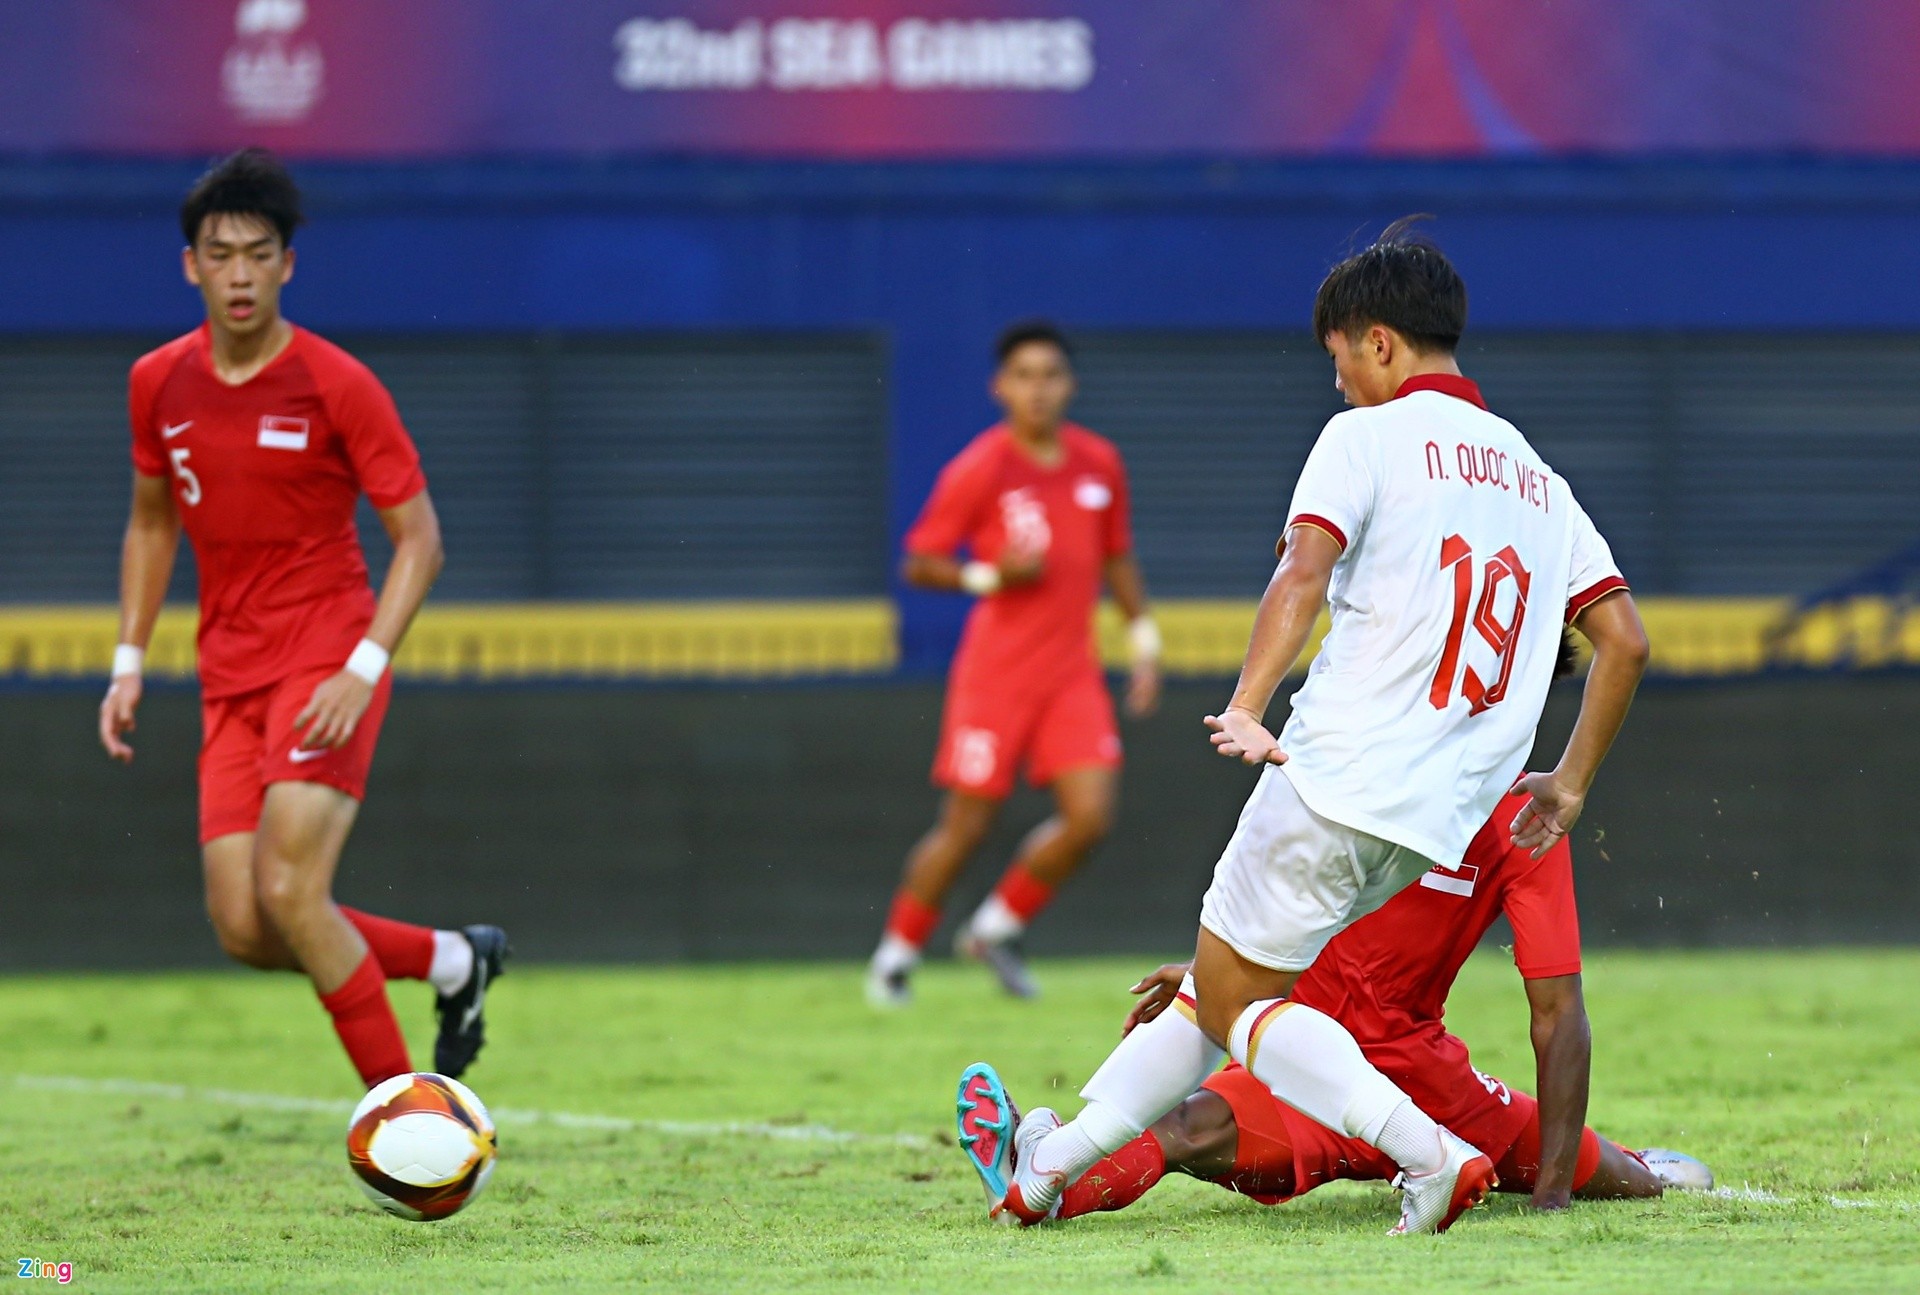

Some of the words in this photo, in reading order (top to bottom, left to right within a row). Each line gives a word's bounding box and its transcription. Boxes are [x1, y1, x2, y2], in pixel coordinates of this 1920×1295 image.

[614, 18, 761, 91] 32nd
[768, 18, 881, 90] SEA
[888, 17, 1094, 90] GAMES
[170, 448, 202, 507] 5
[1456, 443, 1510, 491] QUOC
[1515, 459, 1550, 513] VIET
[1429, 533, 1533, 719] 19
